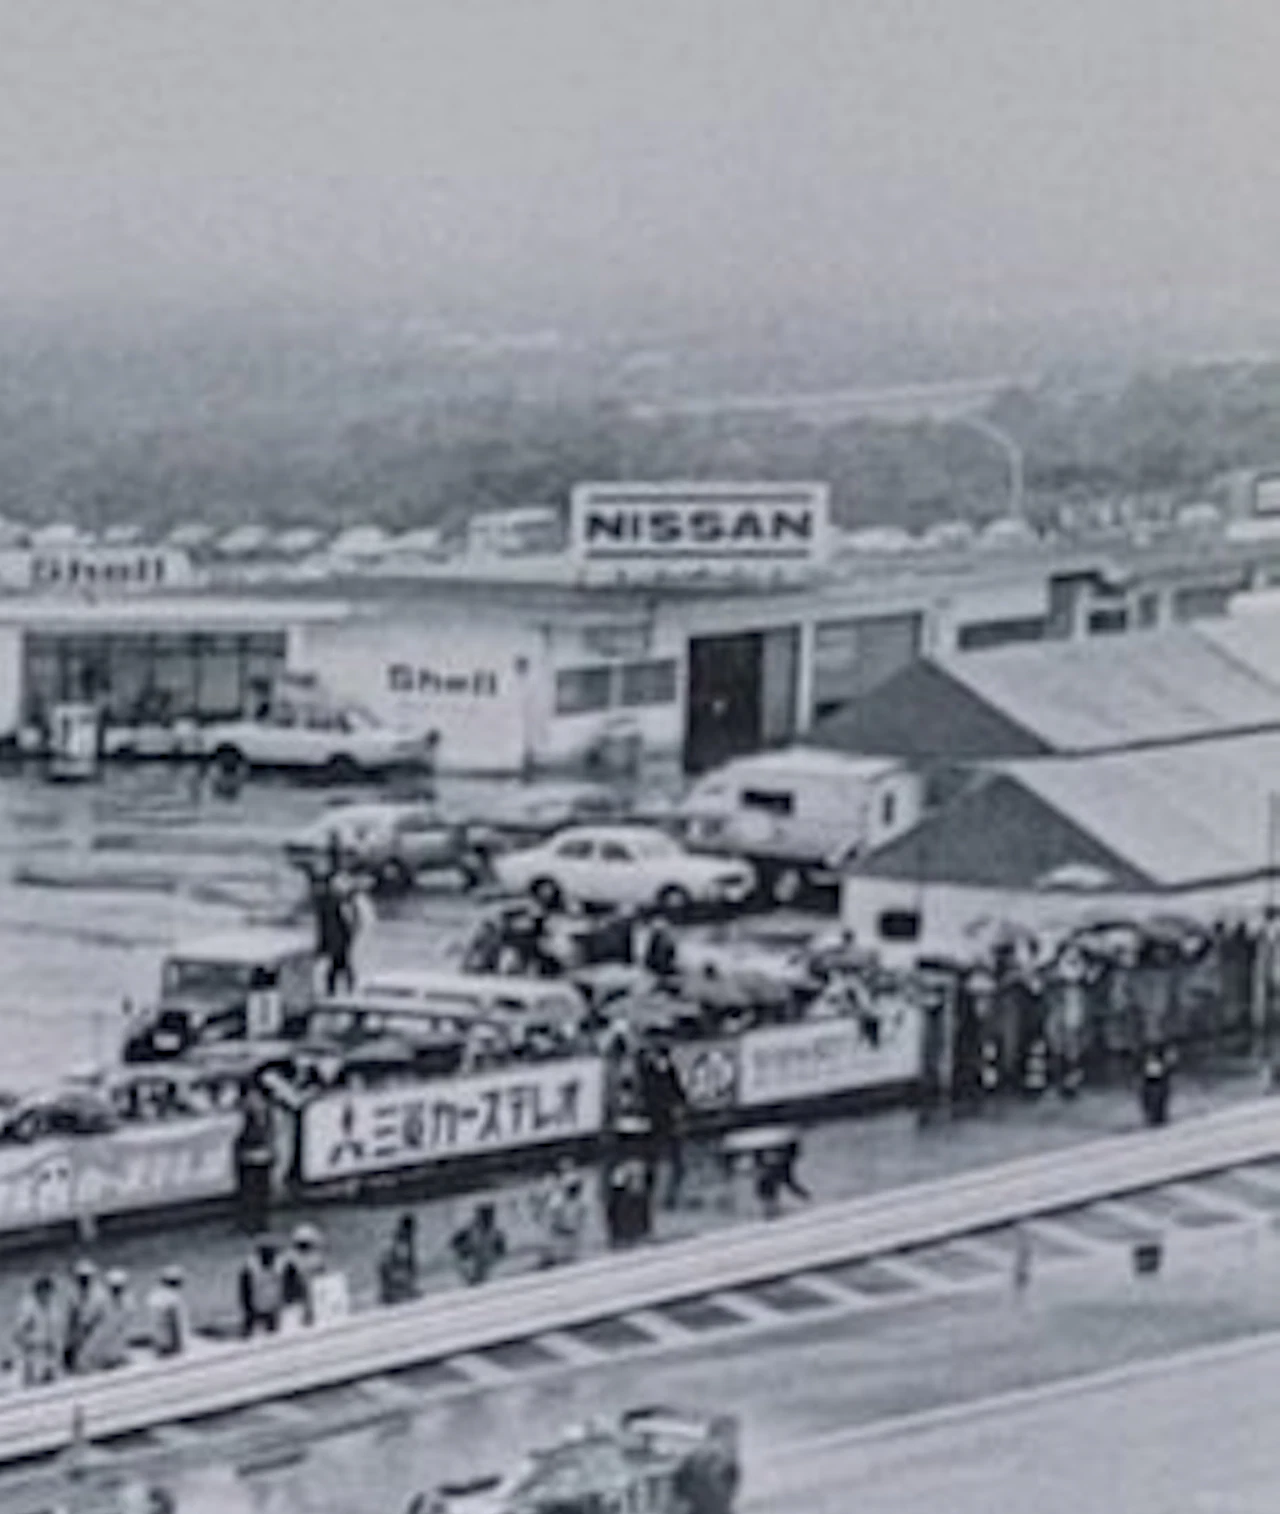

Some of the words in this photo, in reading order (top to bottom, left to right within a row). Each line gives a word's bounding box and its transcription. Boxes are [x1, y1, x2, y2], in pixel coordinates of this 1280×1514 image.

[586, 509, 813, 543] NISSAN
[31, 556, 165, 583] Shell
[386, 663, 497, 698] Shell
